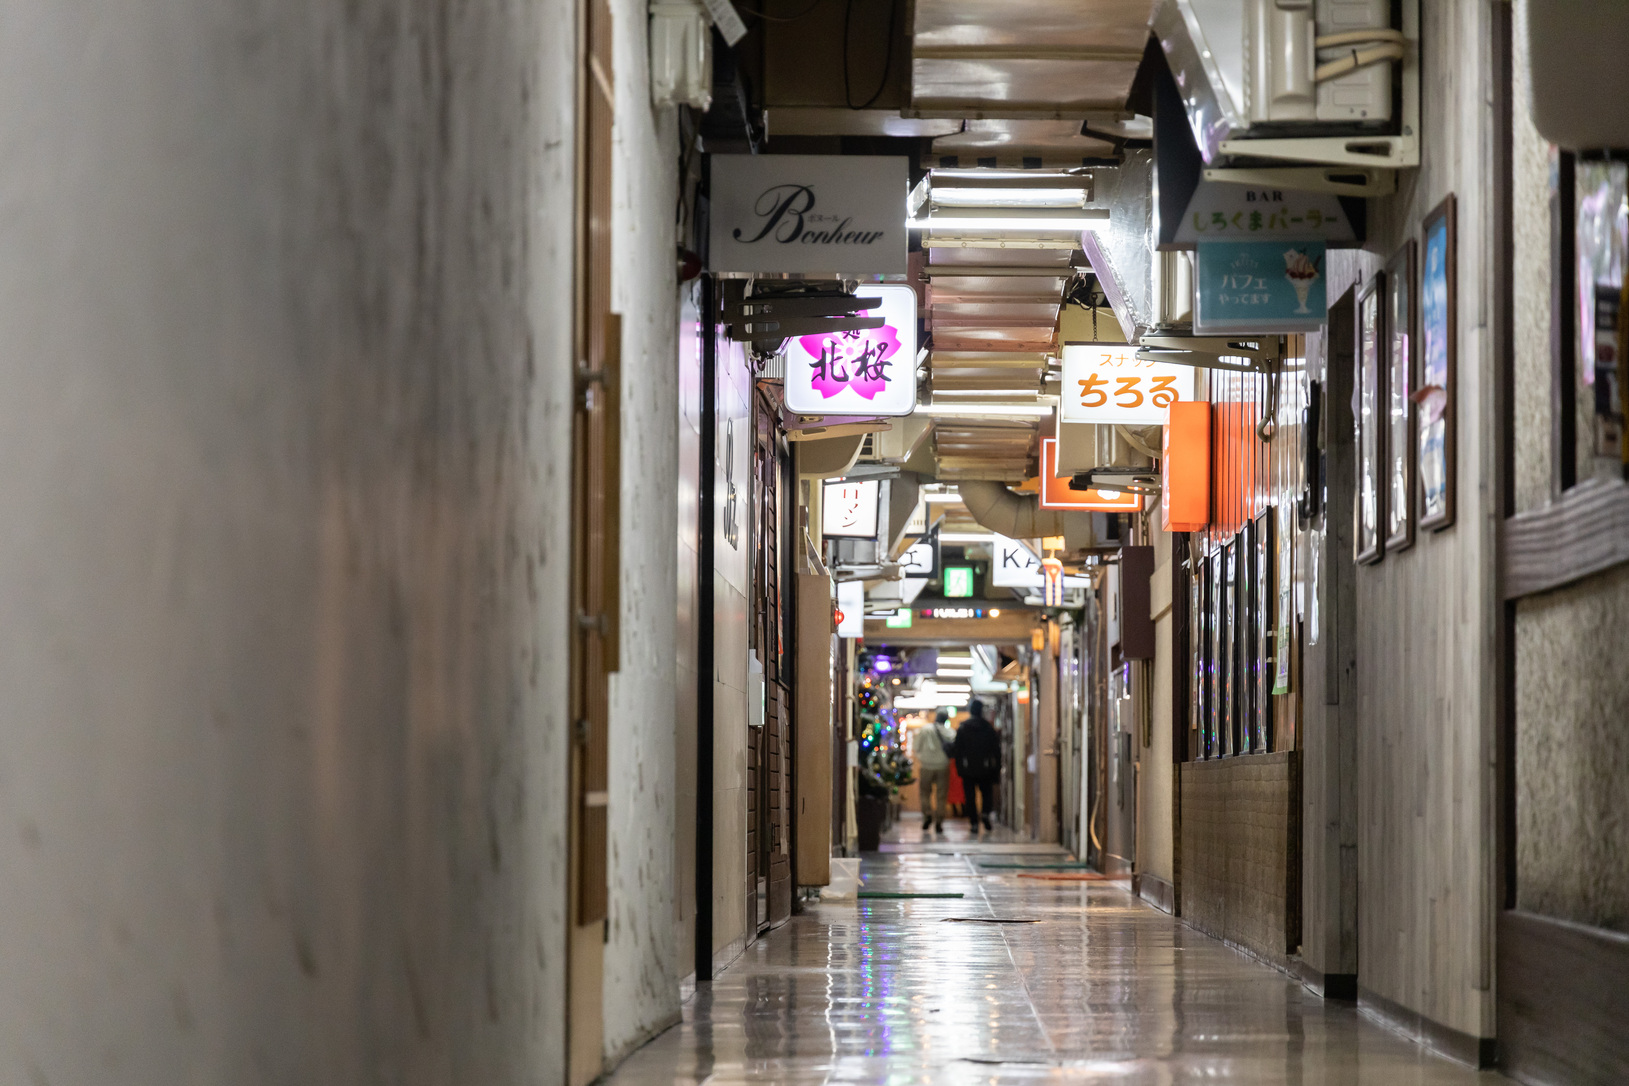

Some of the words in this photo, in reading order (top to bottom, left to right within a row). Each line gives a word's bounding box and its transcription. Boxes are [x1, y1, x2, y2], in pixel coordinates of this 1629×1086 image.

[1246, 190, 1283, 202] BAR
[733, 184, 884, 245] Bonheur
[1193, 207, 1337, 231] しろくまパーラー
[1221, 273, 1267, 290] パフェ
[1218, 293, 1271, 305] やってます
[809, 340, 893, 382] 北桜
[1078, 373, 1179, 408] ちろる
